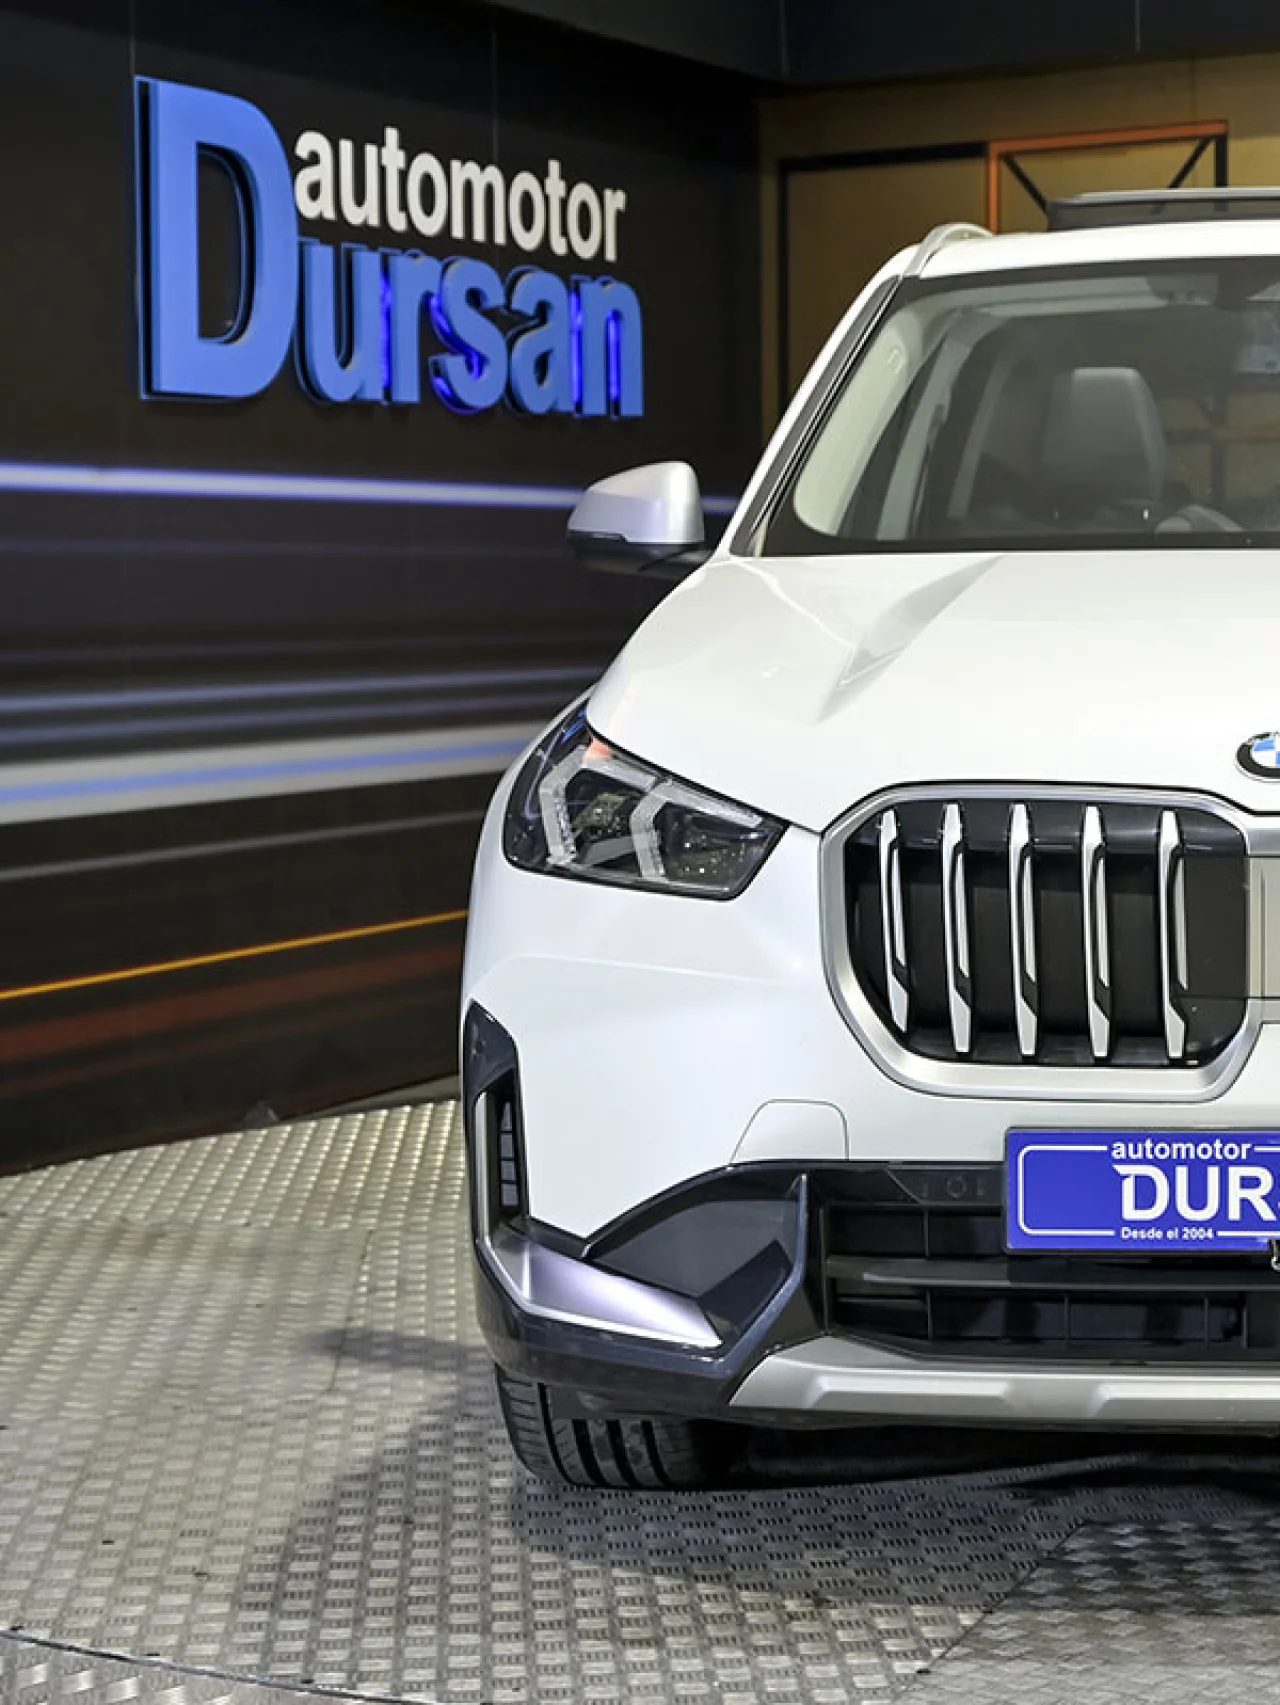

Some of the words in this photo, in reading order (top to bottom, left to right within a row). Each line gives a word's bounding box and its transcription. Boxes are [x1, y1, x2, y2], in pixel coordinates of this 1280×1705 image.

[294, 126, 627, 262] automotor
[134, 75, 645, 419] Dursan
[1112, 1139, 1252, 1160] automotor
[1121, 1227, 1163, 1239] Desde
[1166, 1227, 1179, 1239] el
[1181, 1227, 1214, 1240] 2004
